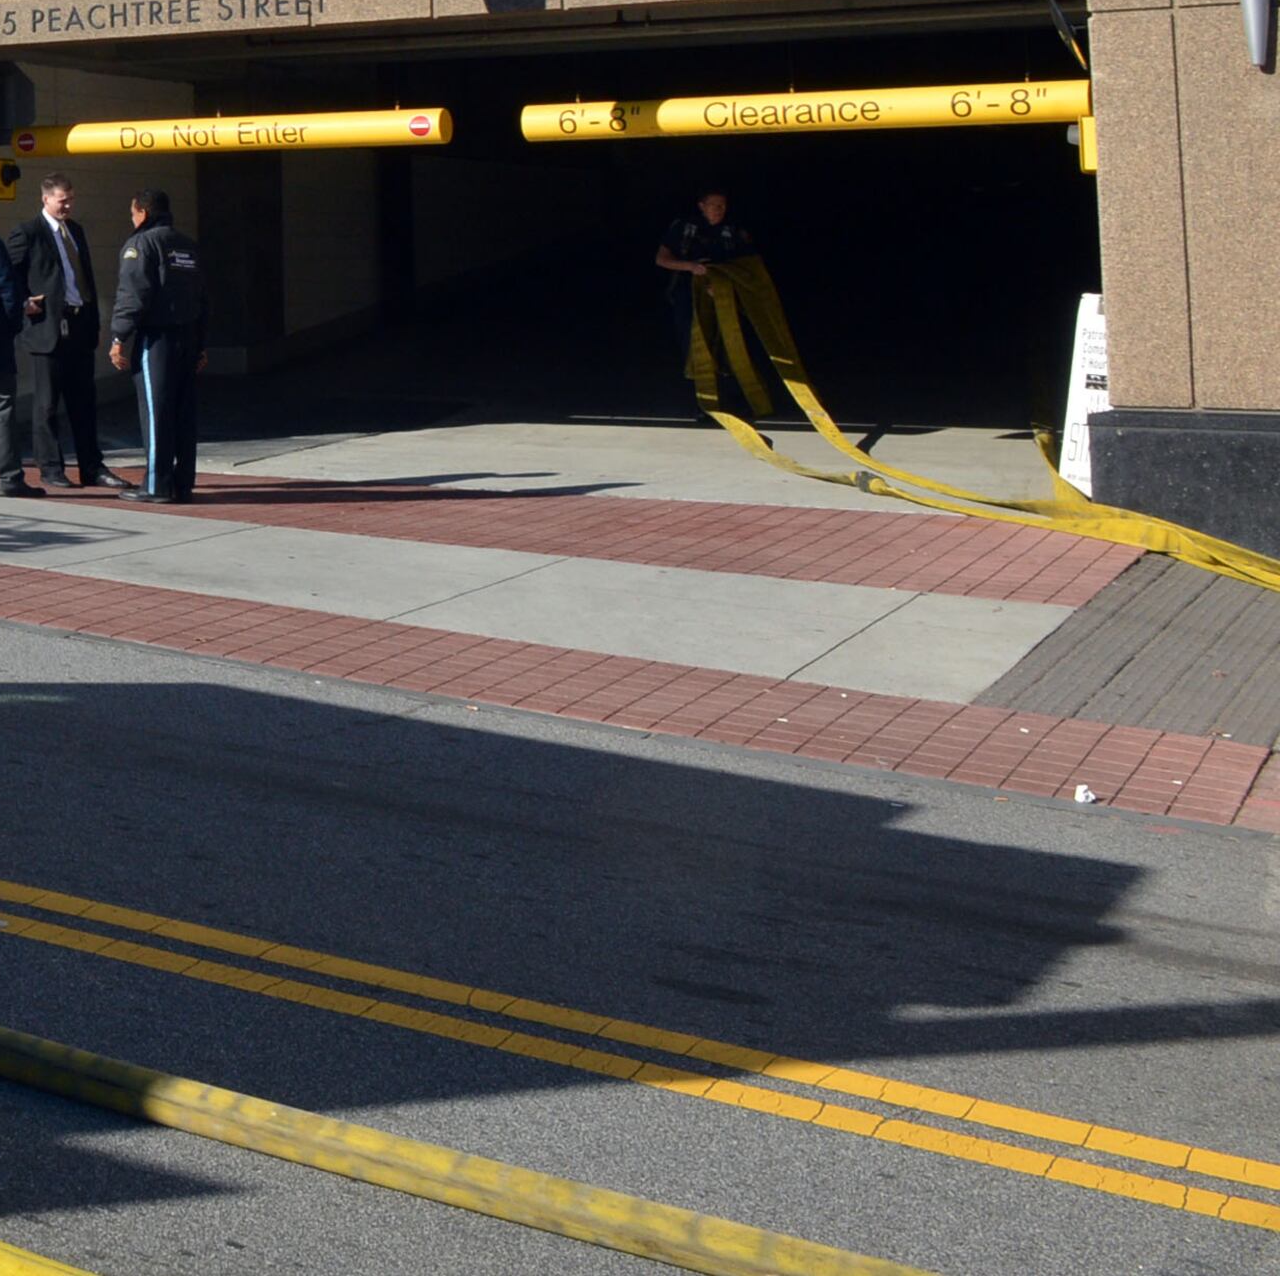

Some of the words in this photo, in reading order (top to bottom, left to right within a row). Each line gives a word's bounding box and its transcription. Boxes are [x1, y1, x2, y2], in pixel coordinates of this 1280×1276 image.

[703, 100, 881, 128] Clearance
[119, 126, 155, 150] Do
[173, 124, 220, 147] Not
[238, 121, 309, 145] Enter
